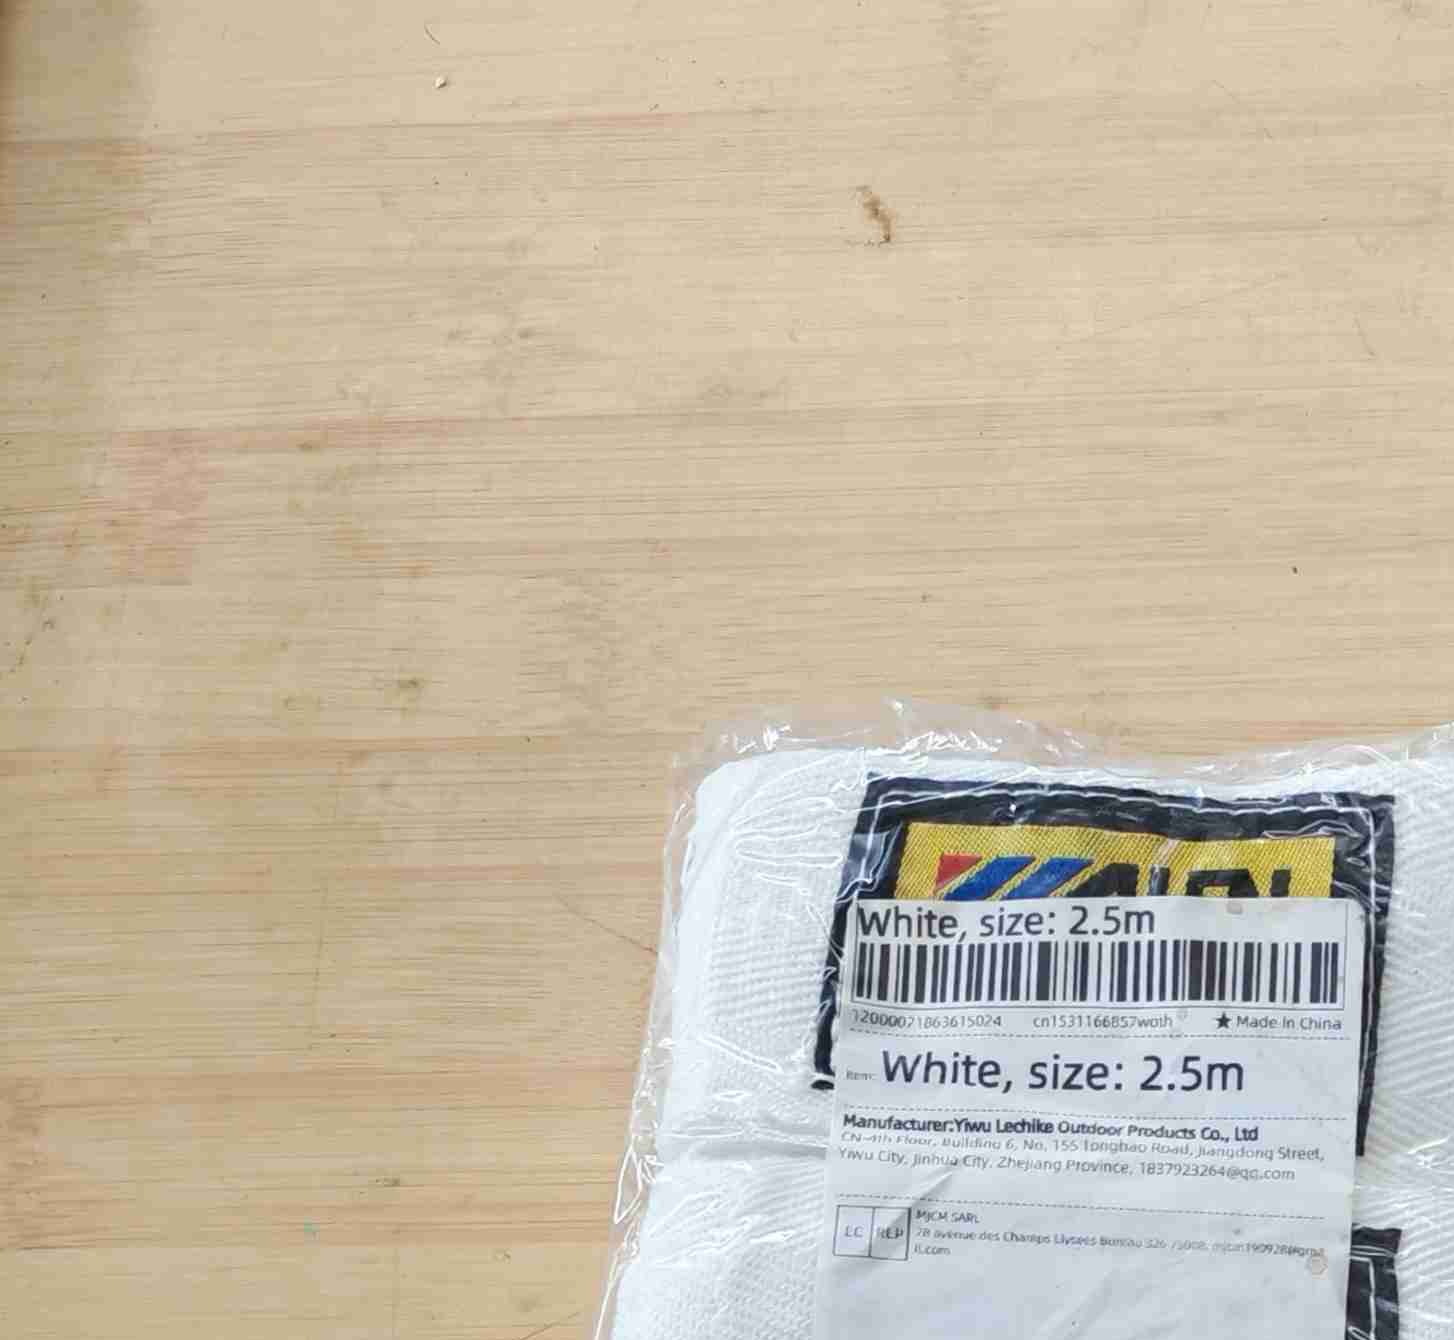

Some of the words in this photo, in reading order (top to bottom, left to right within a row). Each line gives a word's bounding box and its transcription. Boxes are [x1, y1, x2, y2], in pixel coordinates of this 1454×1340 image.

[857, 904, 968, 943] White,
[979, 906, 1056, 938] size:
[1068, 904, 1156, 937] 2.5m
[1236, 1015, 1278, 1029] Made
[1299, 1016, 1342, 1031] China
[882, 1050, 1013, 1094] White,
[1028, 1053, 1124, 1092] size:
[1139, 1054, 1245, 1093] 2.5m
[1057, 1120, 1123, 1136] Outdoor
[1127, 1124, 1197, 1140] Products
[1234, 1125, 1259, 1142] Ltd
